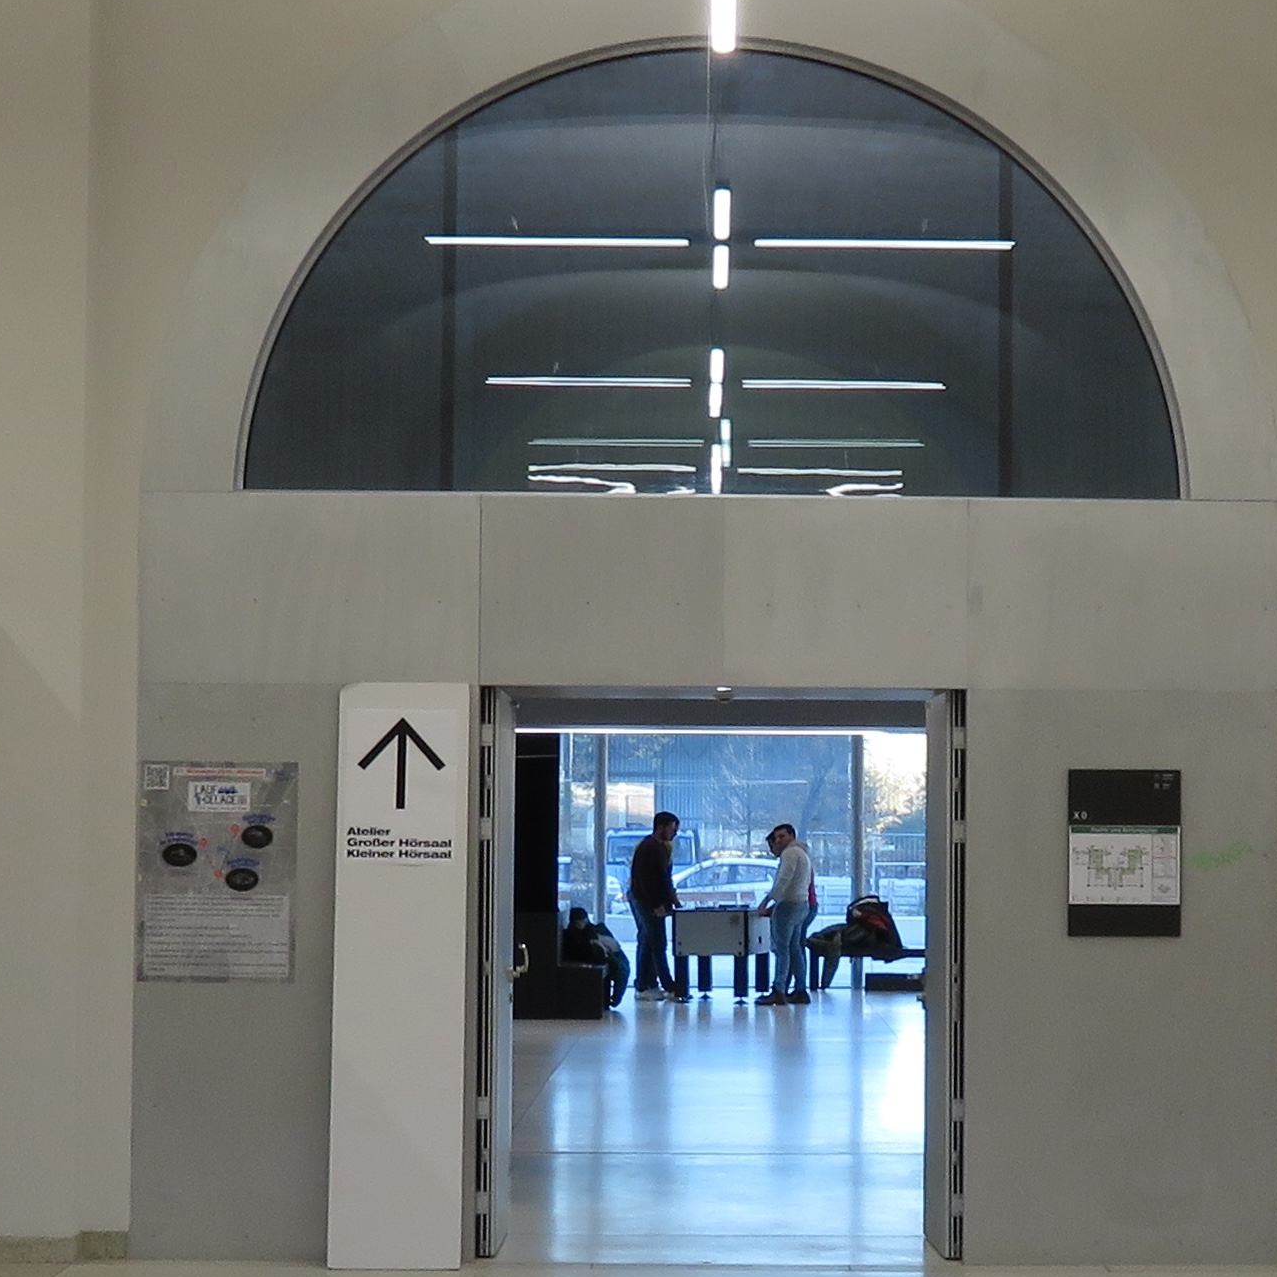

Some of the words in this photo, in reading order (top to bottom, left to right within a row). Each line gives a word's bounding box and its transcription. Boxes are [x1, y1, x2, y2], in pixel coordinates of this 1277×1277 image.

[347, 826, 391, 836] Atelier
[347, 838, 395, 847] Großer
[399, 838, 452, 848] Hörsaal
[347, 849, 395, 858] Kleiner
[399, 849, 452, 859] Hörsaal
